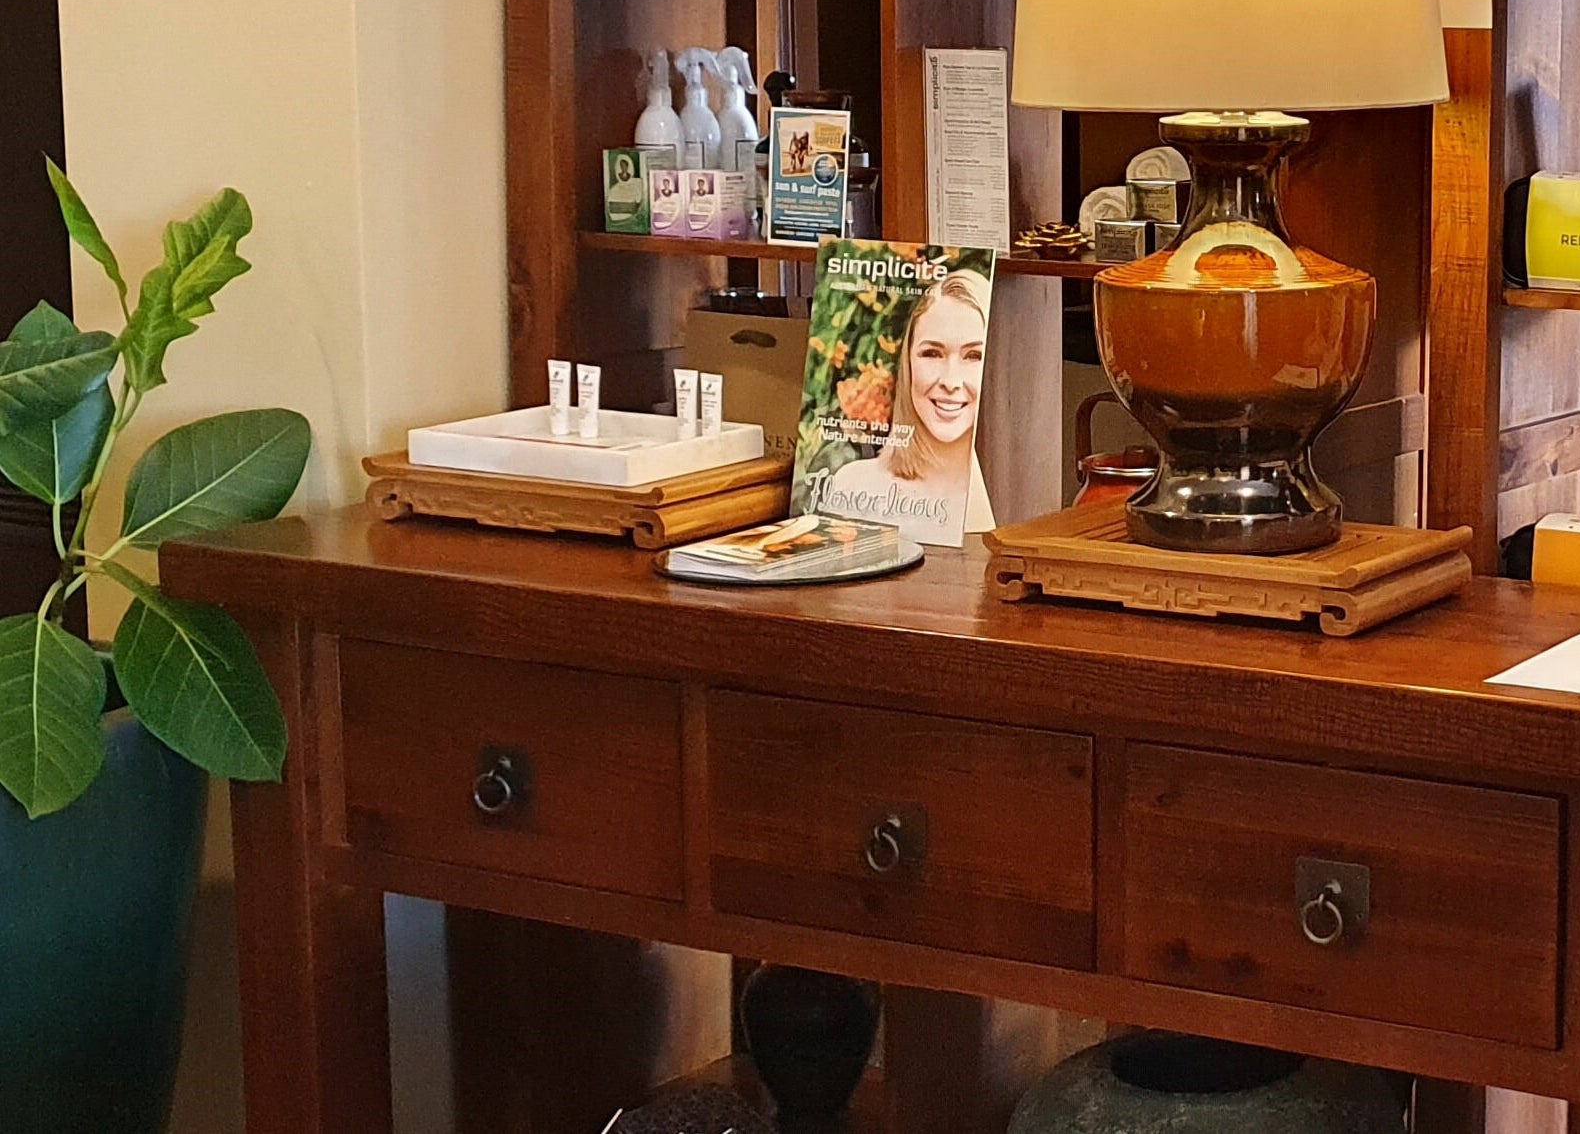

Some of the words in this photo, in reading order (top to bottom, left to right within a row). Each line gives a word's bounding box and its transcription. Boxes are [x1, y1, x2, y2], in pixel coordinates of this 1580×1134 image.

[800, 184, 818, 194] surf
[817, 187, 841, 198] paste
[905, 287, 923, 296] SKIN
[816, 416, 868, 431] nutrients
[870, 421, 890, 433] the
[892, 424, 916, 439] way
[820, 428, 859, 444] Nature
[860, 432, 911, 448] intended
